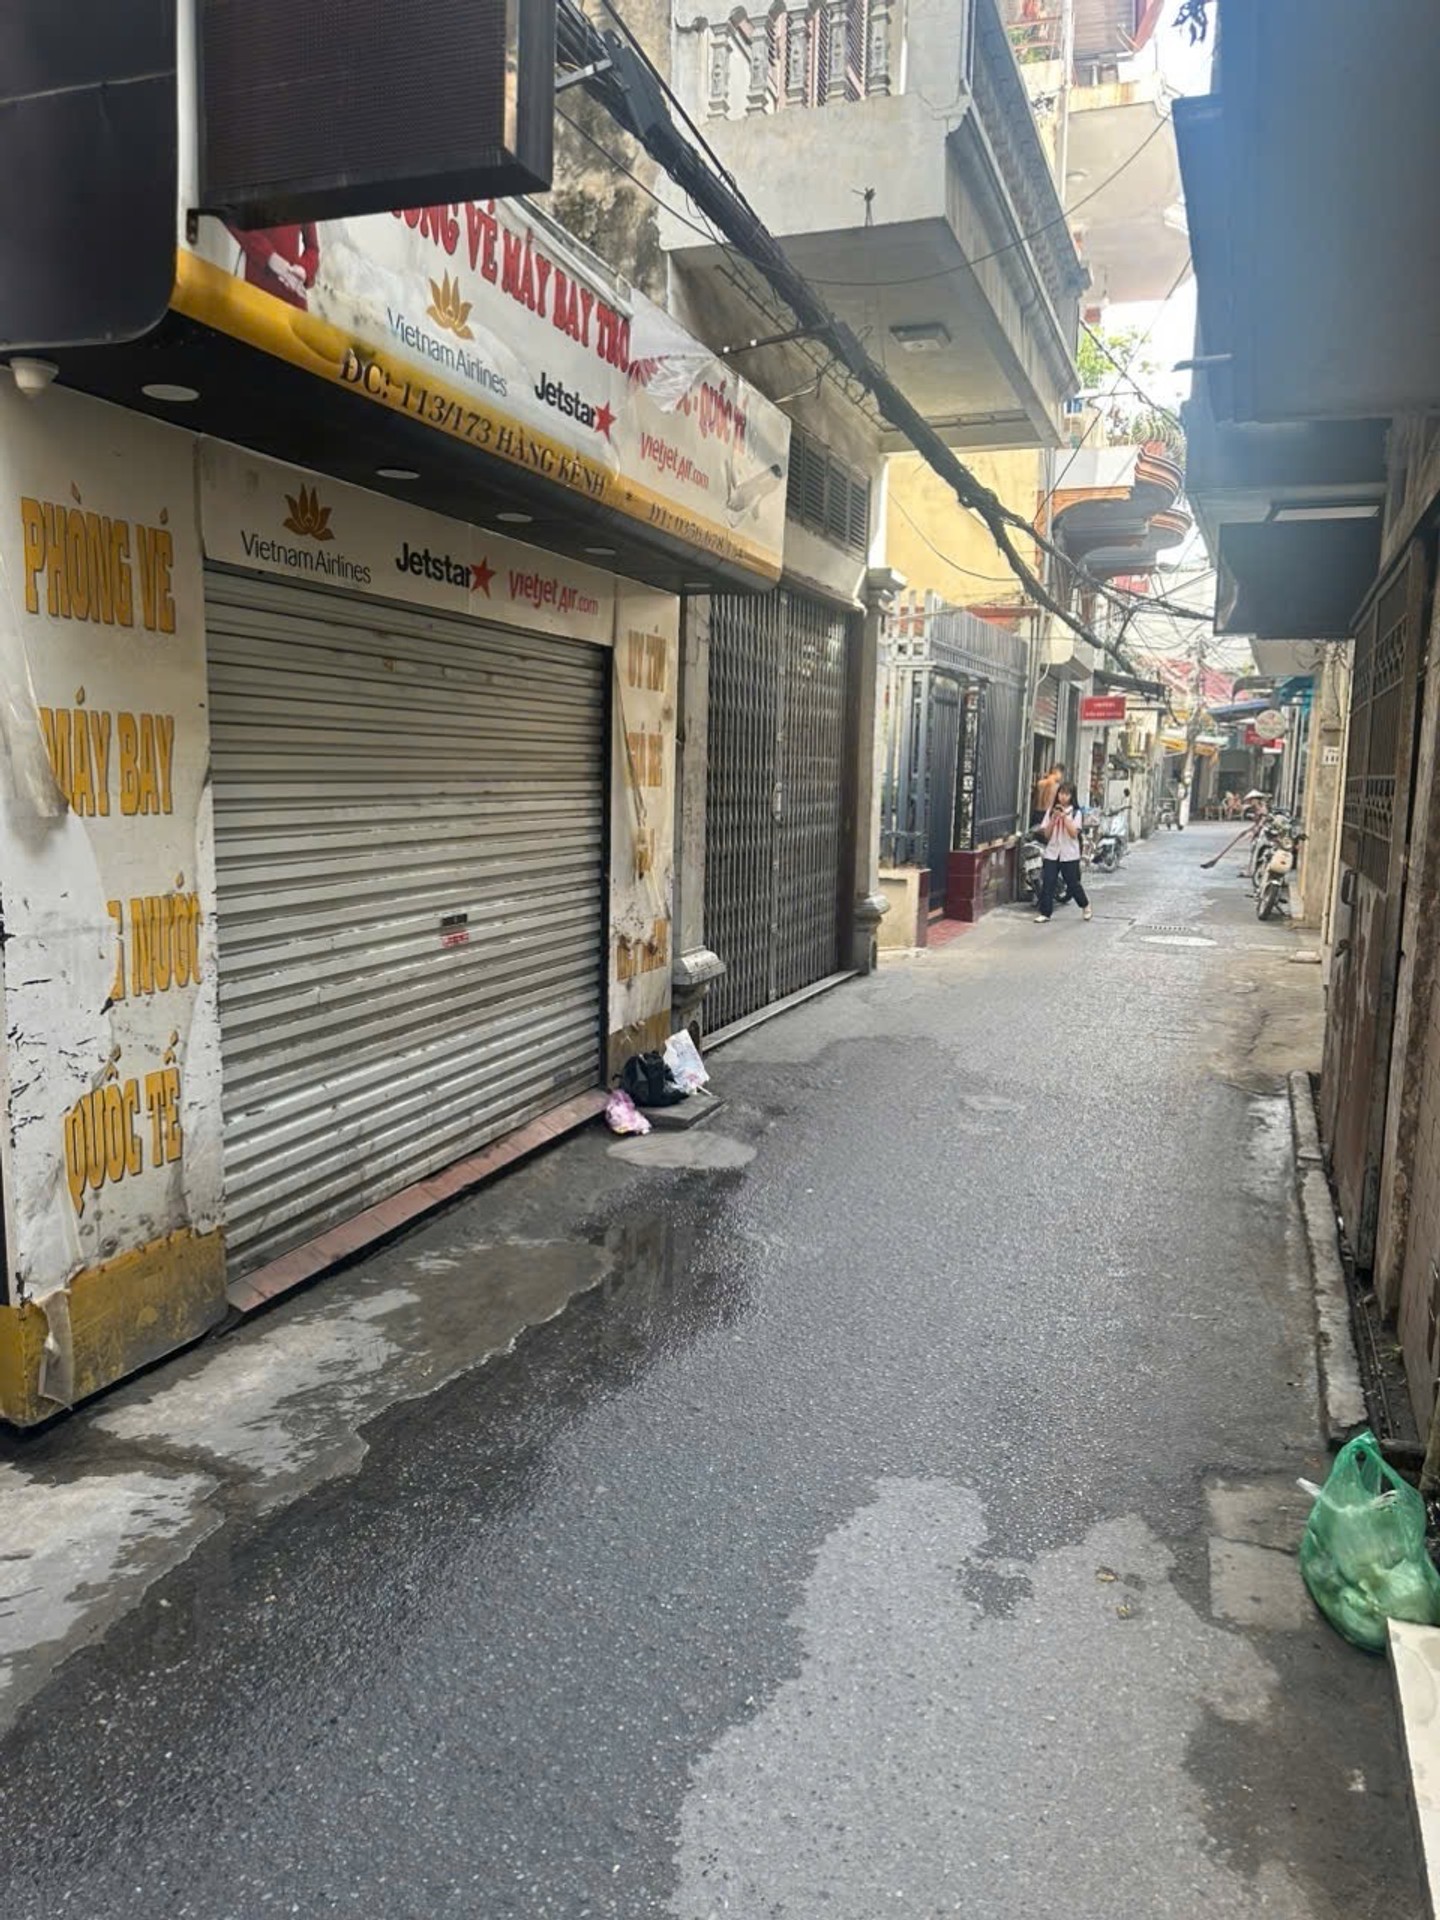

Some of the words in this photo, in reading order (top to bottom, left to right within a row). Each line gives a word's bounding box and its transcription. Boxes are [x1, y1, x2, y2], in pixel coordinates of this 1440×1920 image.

[501, 227, 551, 319] MÁY
[553, 267, 594, 348] BAY
[387, 306, 455, 367] Vietnam
[456, 349, 508, 398] Airlines
[403, 383, 492, 445] 113/173
[496, 425, 554, 473] HÀNG
[558, 450, 606, 494] KÊNH
[534, 372, 597, 429] Jetstar
[240, 530, 313, 571] Vietnam
[315, 550, 372, 584] Airlines
[395, 542, 472, 588] Jetstar
[118, 711, 174, 815] BAY
